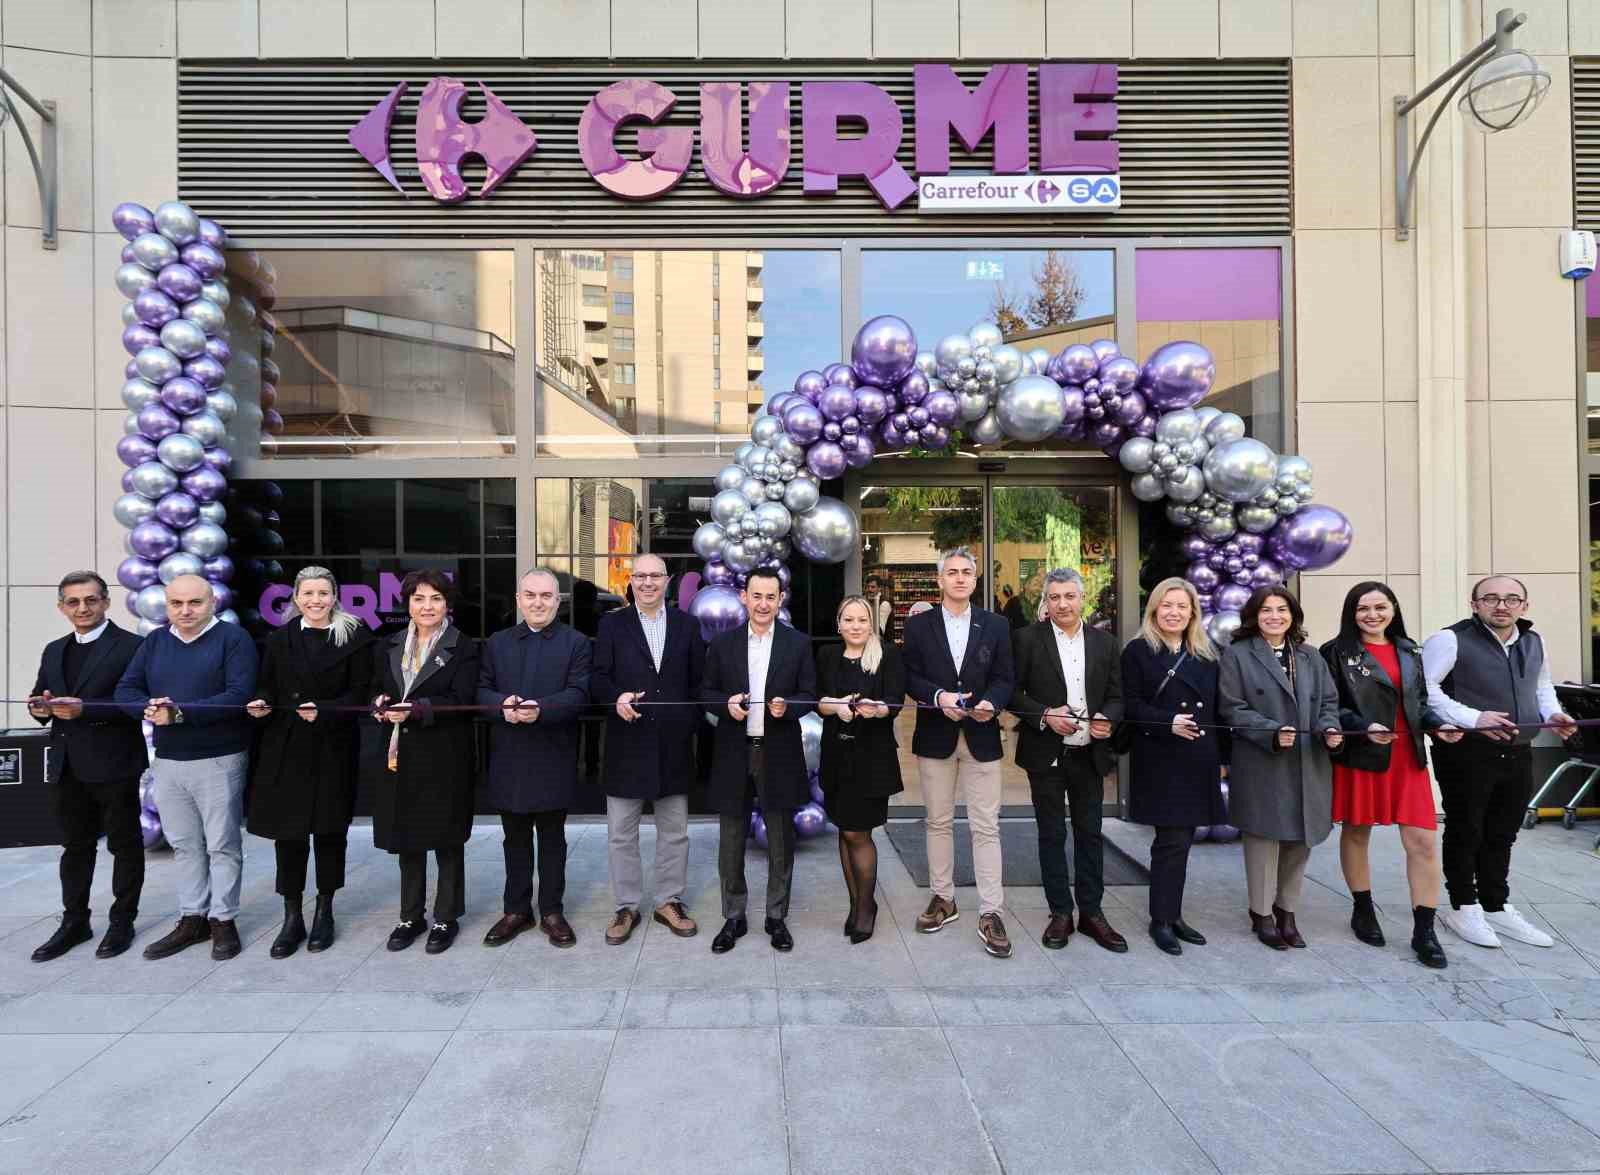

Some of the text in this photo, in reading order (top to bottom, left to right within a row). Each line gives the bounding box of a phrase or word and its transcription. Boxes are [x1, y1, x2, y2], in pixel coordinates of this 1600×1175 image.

[578, 63, 1119, 209] GURME
[922, 181, 1117, 201] Carrefour SA
